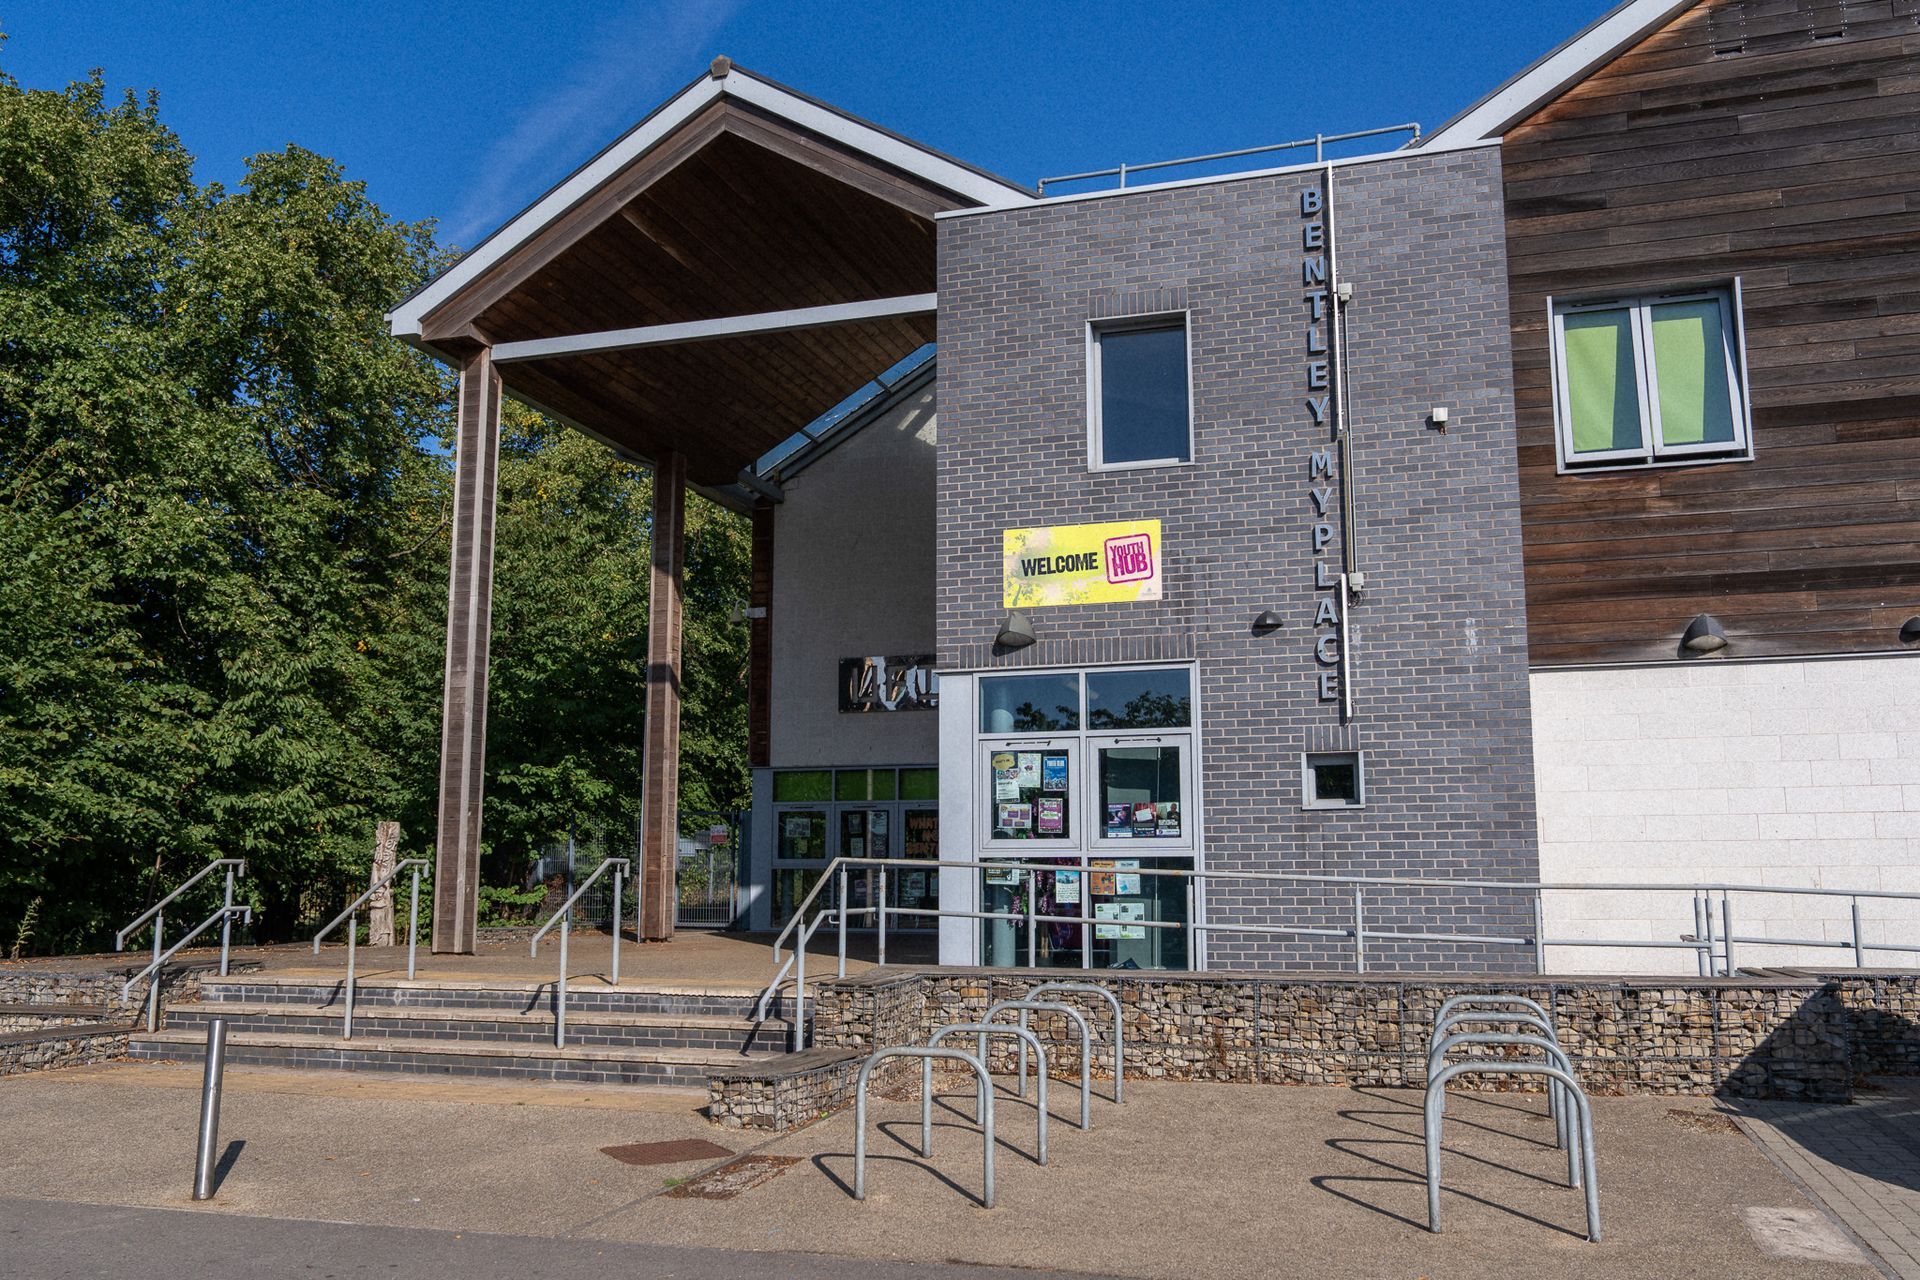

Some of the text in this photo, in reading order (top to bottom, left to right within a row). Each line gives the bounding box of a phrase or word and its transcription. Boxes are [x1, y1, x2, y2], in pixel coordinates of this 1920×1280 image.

[1302, 187, 1340, 700] BENTLEY MYPLACE
[1110, 541, 1144, 557] YOUTH
[1021, 552, 1098, 576] WELCOME
[1112, 553, 1148, 577] HUB
